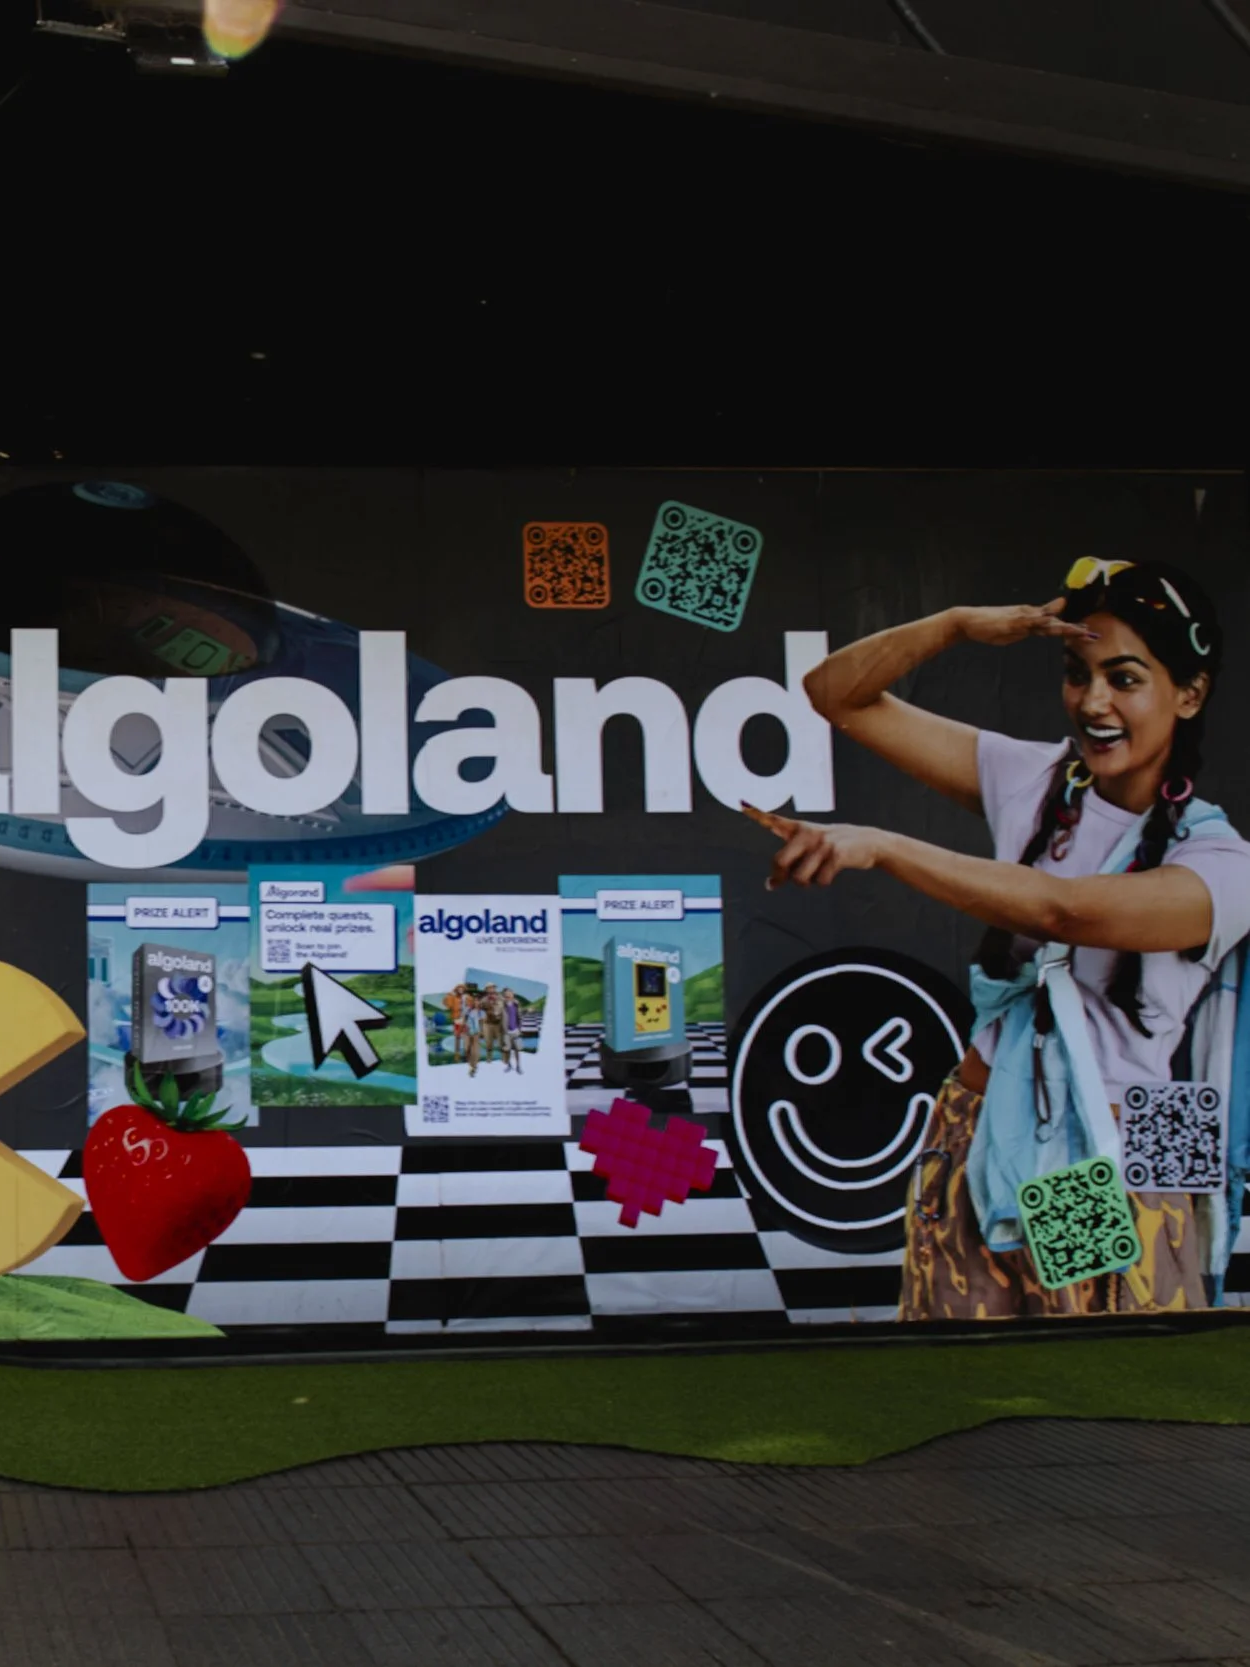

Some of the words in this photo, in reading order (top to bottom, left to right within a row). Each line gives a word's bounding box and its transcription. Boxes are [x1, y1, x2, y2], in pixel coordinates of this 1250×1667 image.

[603, 899, 637, 910] PRIZE
[639, 899, 676, 910] ALERT
[134, 907, 170, 918] PRIZE
[172, 907, 210, 918] ALERT
[265, 909, 325, 922] Complete
[328, 910, 374, 922] quests,
[265, 922, 306, 933] unlock
[309, 922, 333, 933] real
[335, 922, 375, 935] prizes.
[418, 908, 548, 940] algoland
[476, 936, 495, 944] LIVE
[616, 942, 681, 964] algoland
[146, 950, 213, 973] algoland
[164, 998, 201, 1013] 100K
